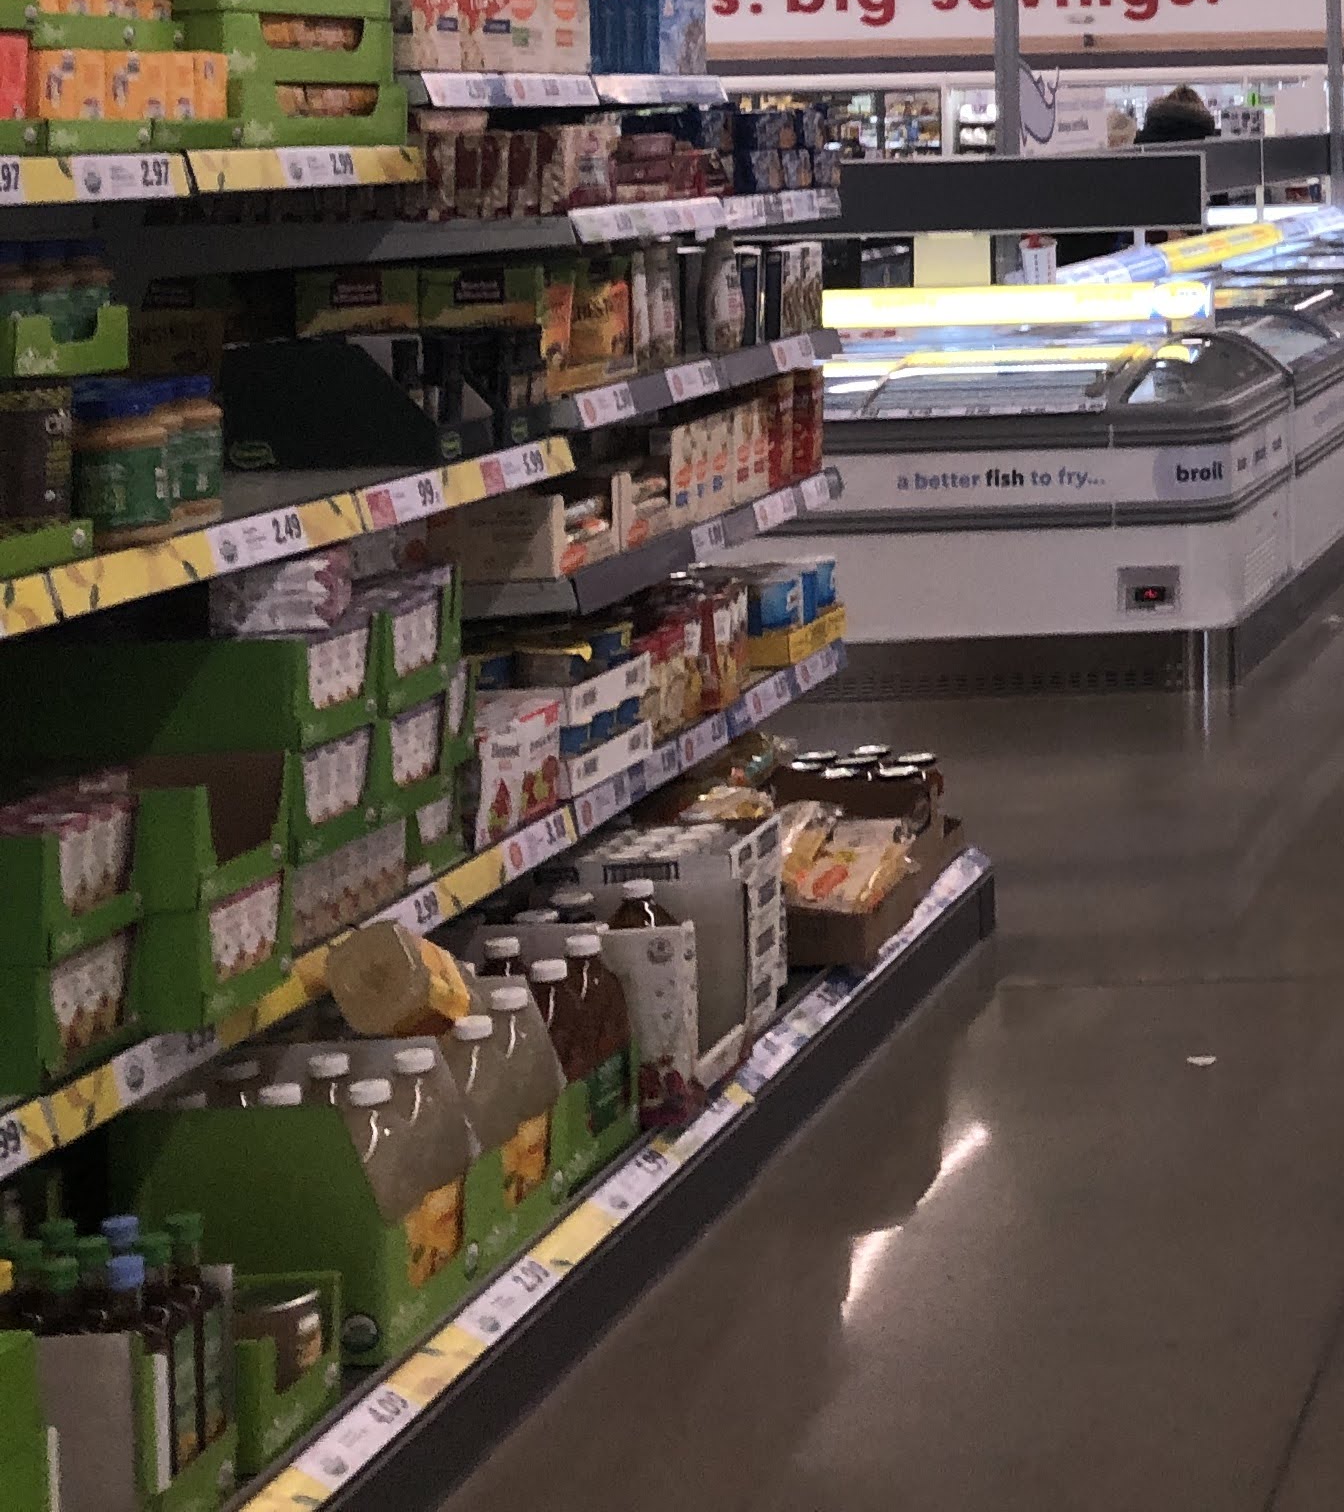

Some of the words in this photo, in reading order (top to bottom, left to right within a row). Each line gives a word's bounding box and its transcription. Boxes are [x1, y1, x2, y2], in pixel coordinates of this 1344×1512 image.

[140, 158, 169, 187] 2.97
[897, 472, 907, 488] a
[914, 467, 980, 488] better
[985, 467, 1025, 487] fish
[1030, 470, 1051, 485] to
[1175, 460, 1223, 482] broil
